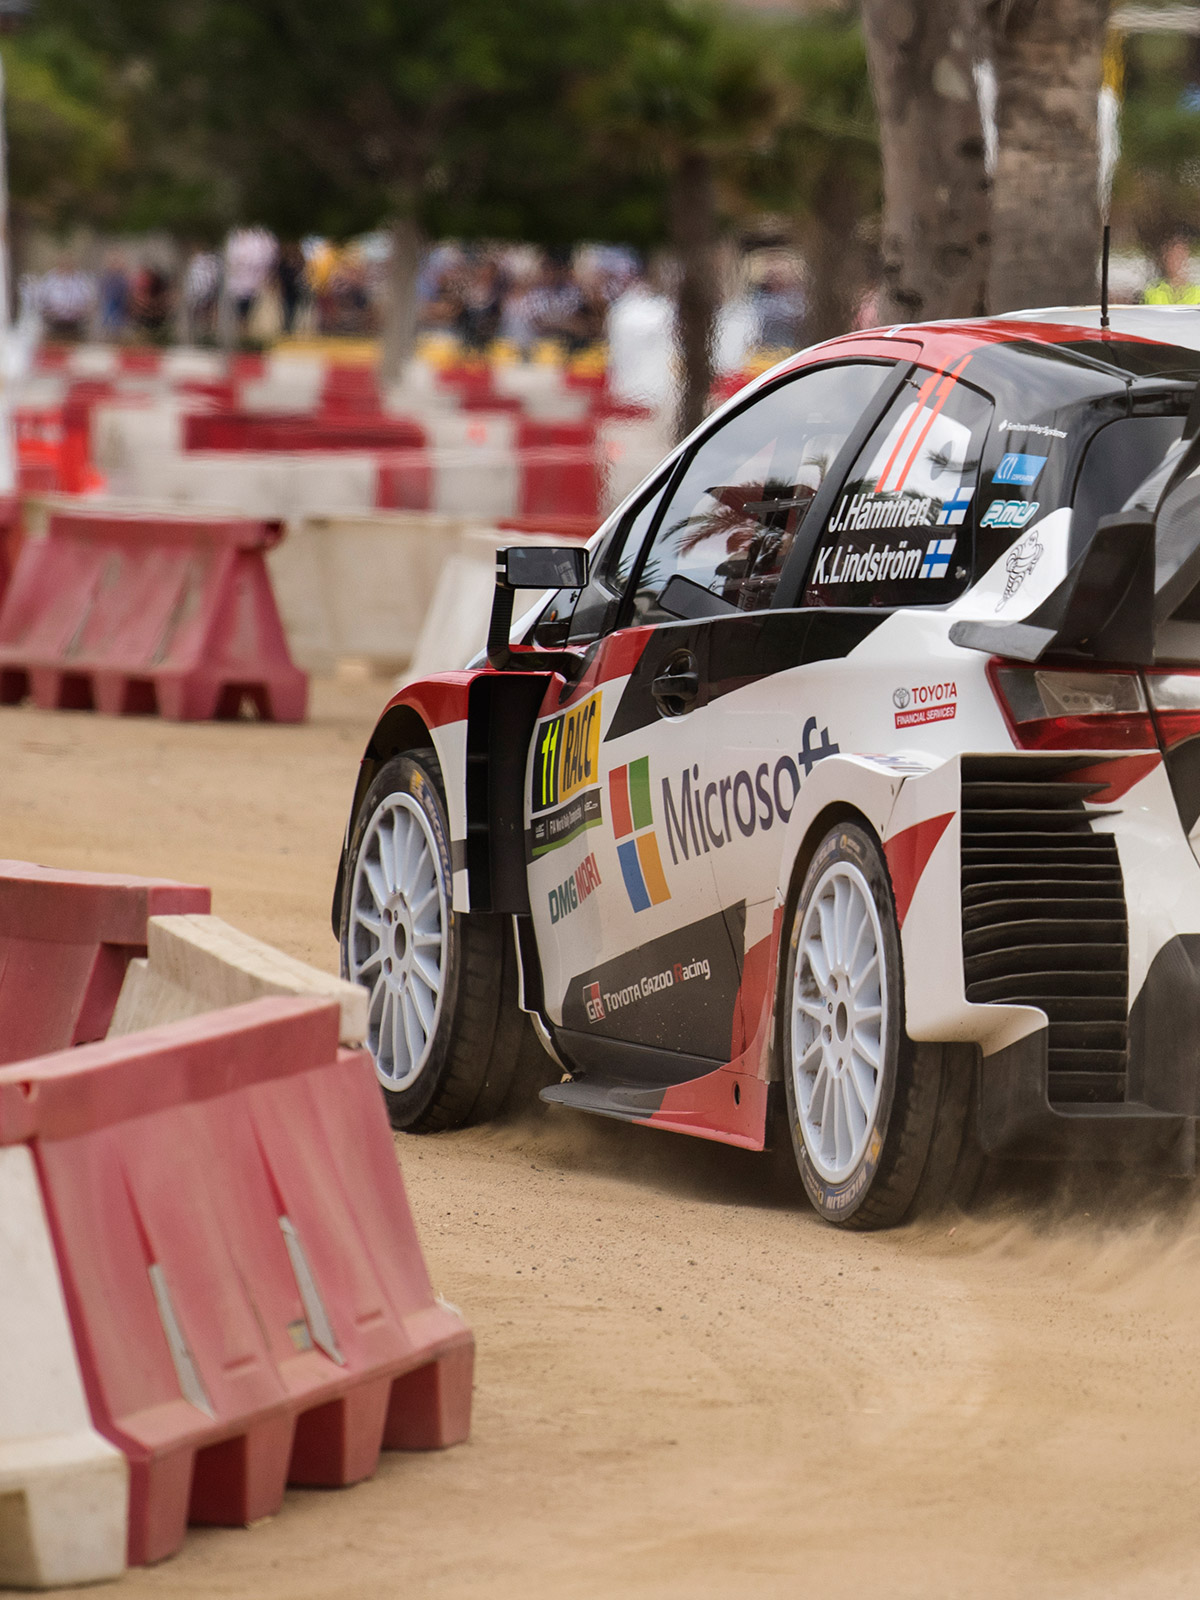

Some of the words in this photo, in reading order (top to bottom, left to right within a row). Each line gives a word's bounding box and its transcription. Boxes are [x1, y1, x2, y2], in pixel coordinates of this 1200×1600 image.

[812, 540, 922, 585] K.Lindström
[896, 711, 926, 726] FINANCIAL
[926, 706, 955, 721] SERVICES
[911, 682, 957, 704] TOYOTA
[542, 719, 560, 806] 11
[562, 700, 596, 792] RACC
[548, 875, 578, 925] DMG
[575, 852, 602, 904] MORI
[586, 997, 605, 1021] GR
[603, 983, 641, 1013] TOYOTA
[640, 969, 674, 997] GAZOO
[673, 957, 711, 983] Racing
